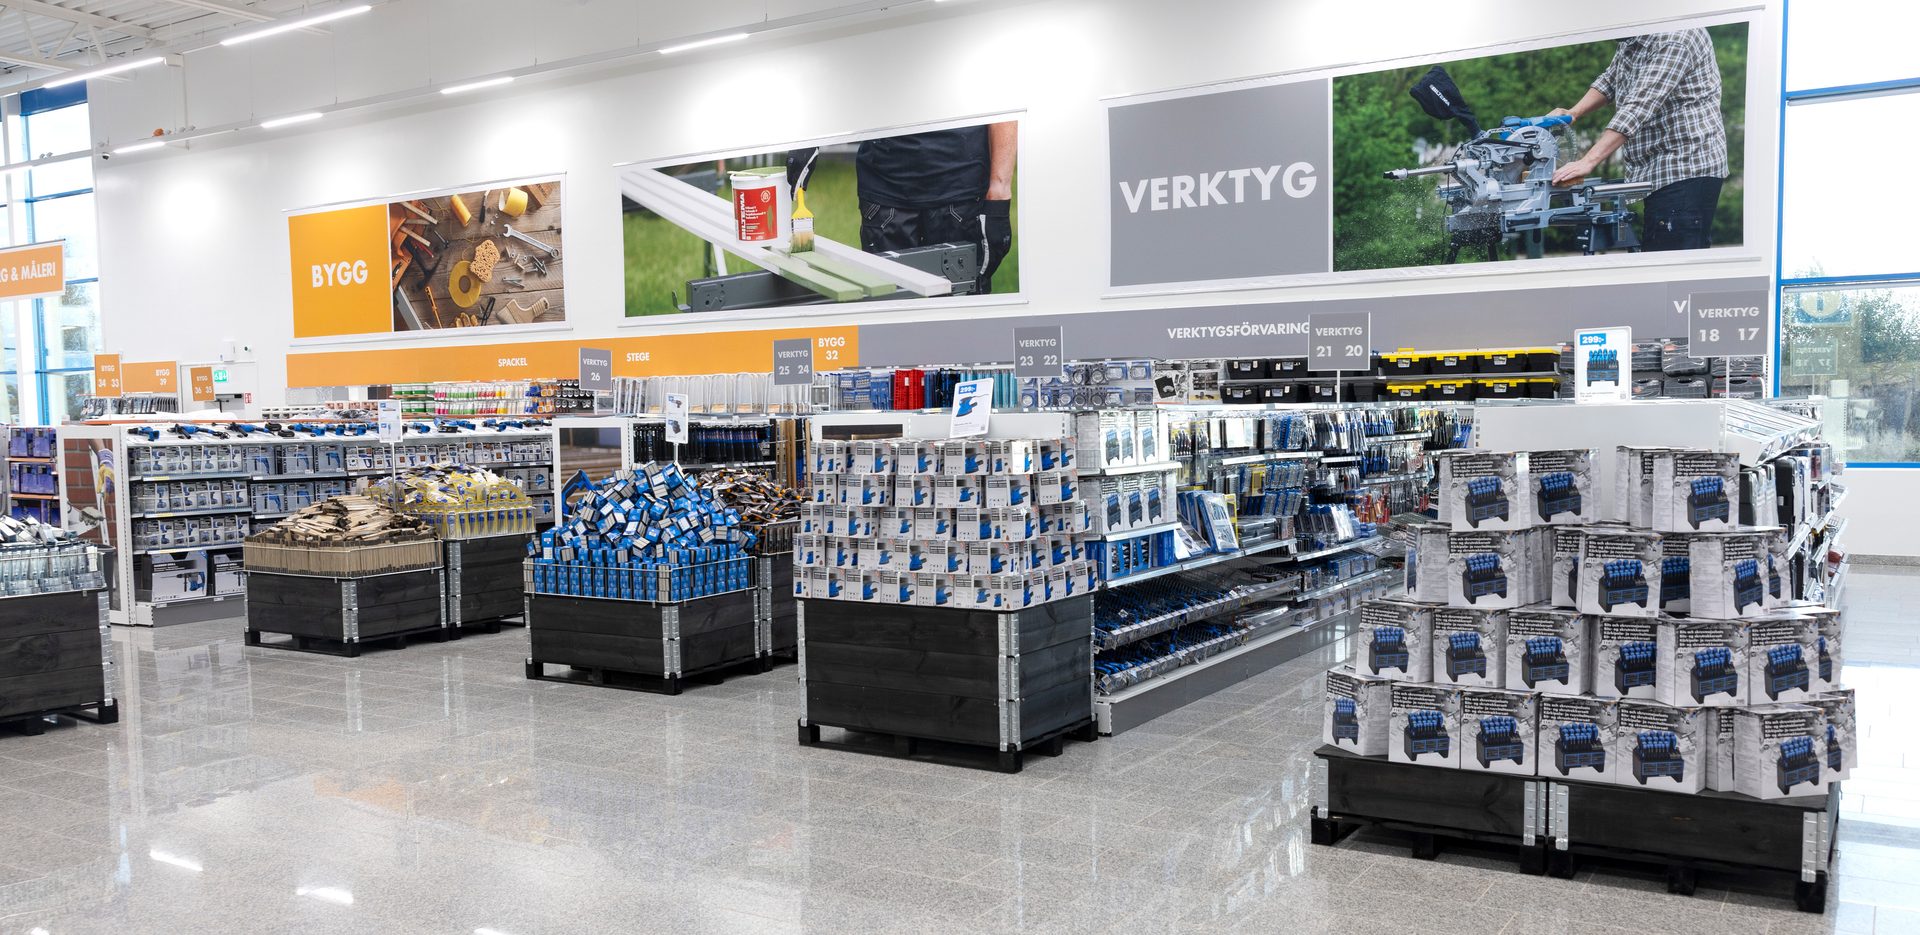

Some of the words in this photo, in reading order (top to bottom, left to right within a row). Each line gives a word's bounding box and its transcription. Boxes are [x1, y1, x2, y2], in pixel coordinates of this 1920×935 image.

[1119, 161, 1317, 213] VERKTYG
[11, 266, 19, 281] &
[21, 260, 56, 280] MÅLERI
[311, 260, 368, 288] BYGG
[1698, 307, 1760, 319] VERKTYG
[1167, 322, 1310, 339] VERKTYGSFÖRVARING
[1315, 326, 1363, 337] VERKTYG
[1699, 329, 1720, 342] 18
[1738, 328, 1760, 341] 17
[818, 336, 846, 347] BYGG
[1019, 338, 1057, 348] VERKTYG
[626, 352, 650, 361] STEGE
[778, 350, 809, 359] VERKTYG
[825, 350, 838, 360] 32
[1316, 345, 1332, 357] 21
[1345, 345, 1363, 357] 20
[498, 357, 528, 367] SPACKEL
[582, 358, 608, 367] VERKTYG
[1019, 356, 1034, 366] 23
[1043, 355, 1058, 365] 22
[778, 366, 790, 375] 25
[798, 365, 810, 374] 24
[590, 372, 600, 381] 26
